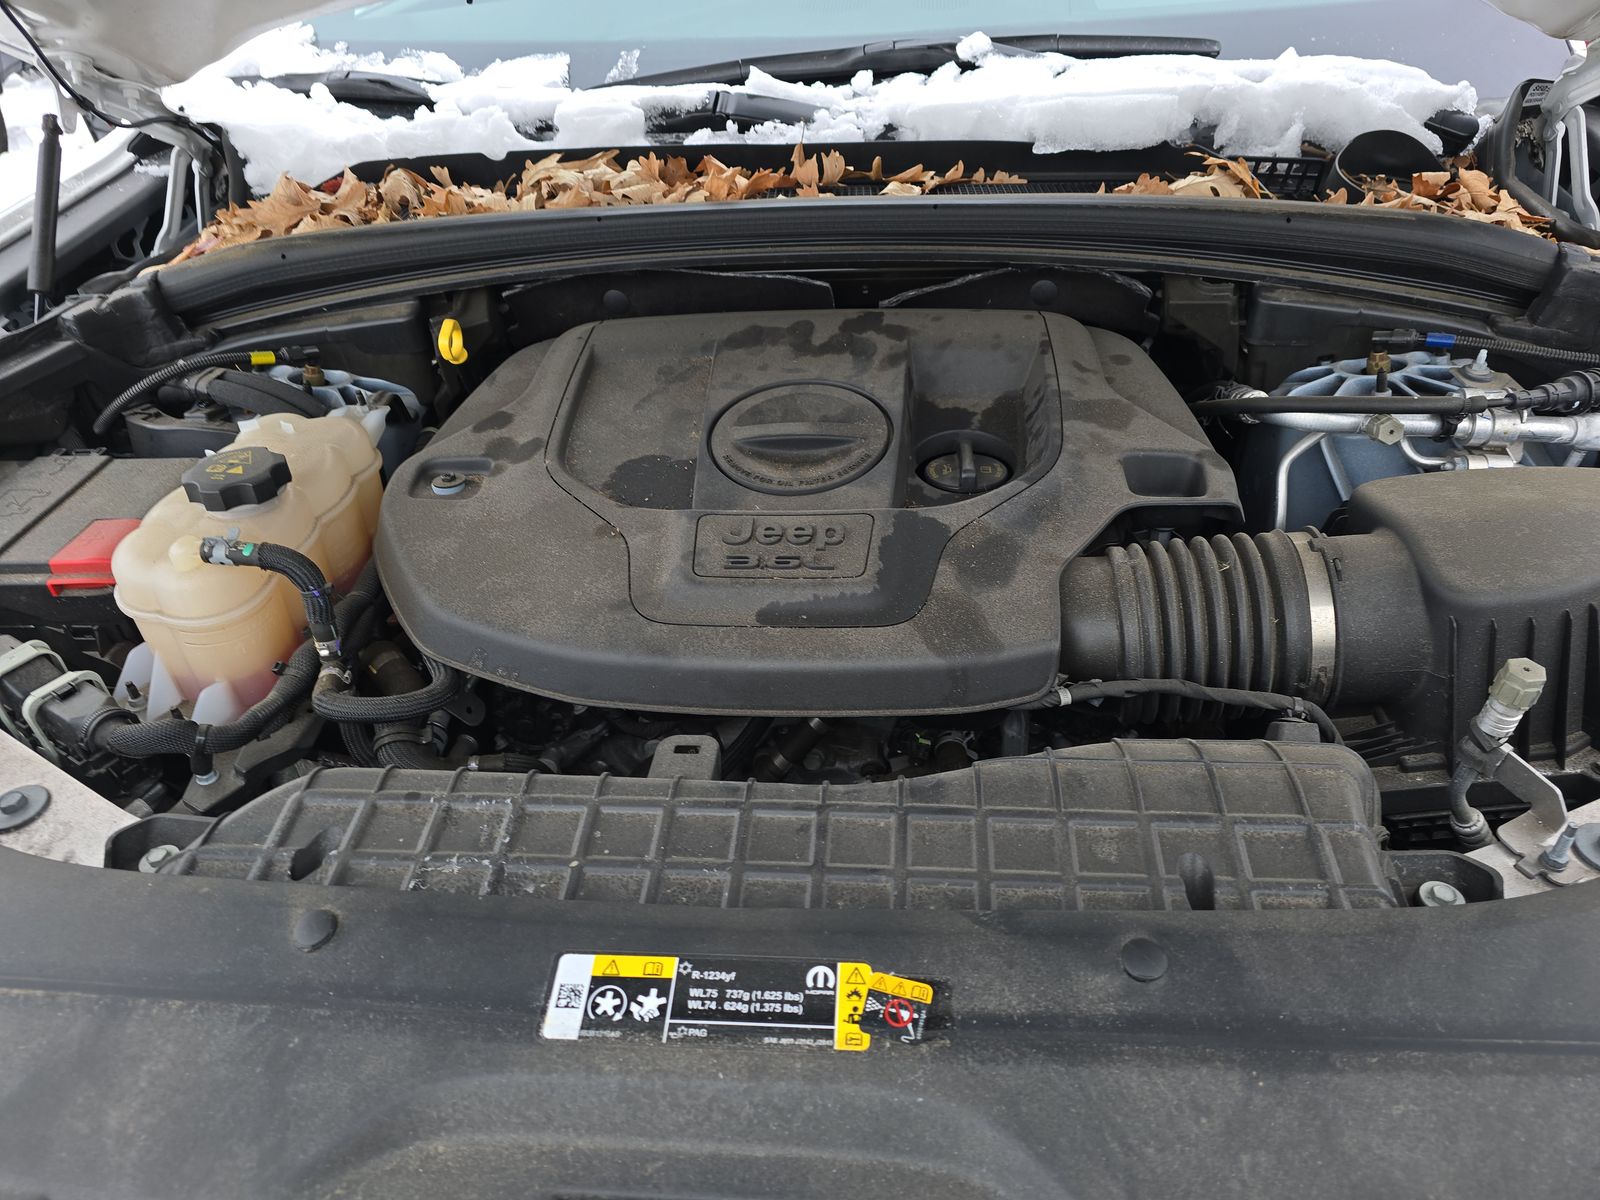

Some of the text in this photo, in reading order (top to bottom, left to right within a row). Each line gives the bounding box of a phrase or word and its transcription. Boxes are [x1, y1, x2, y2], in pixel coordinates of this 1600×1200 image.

[752, 474, 773, 485] FOR
[777, 479, 794, 487] OIL
[721, 516, 846, 551] Jeep
[723, 554, 836, 571] 3.6L
[691, 970, 737, 983] R-1234yf
[688, 987, 805, 1003] WL75 737g (1.625 lbs)
[687, 999, 804, 1015] WL74 624g (1.375 lbs)
[688, 1028, 708, 1038] PAG
